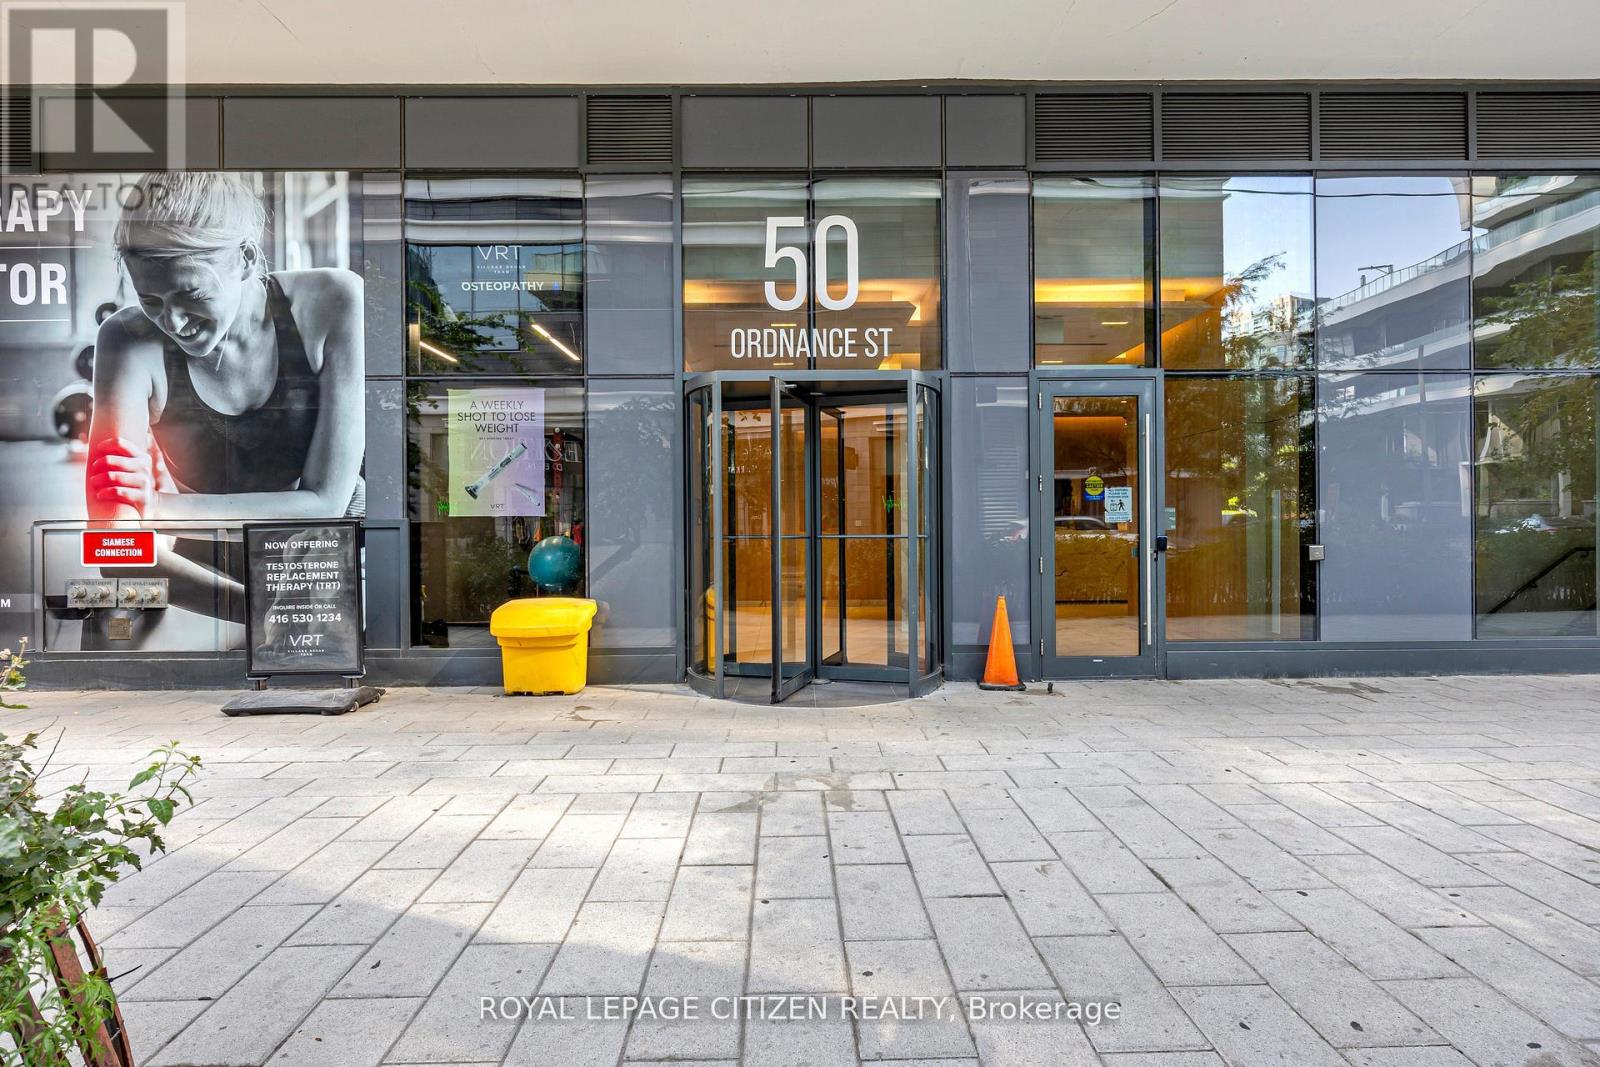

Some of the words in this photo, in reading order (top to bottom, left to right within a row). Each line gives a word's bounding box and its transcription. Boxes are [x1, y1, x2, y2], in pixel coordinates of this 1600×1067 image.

[0, 189, 93, 233] APY
[477, 245, 523, 260] VRT
[764, 215, 859, 311] 50
[461, 281, 545, 291] OSTEOPATHY
[730, 328, 858, 358] ORDNANCE
[864, 328, 893, 357] ST
[469, 400, 478, 410] A
[481, 400, 524, 410] WEEKLY
[457, 411, 486, 422] SHOT
[490, 411, 506, 422] TO
[509, 411, 536, 422] LOSE
[474, 423, 520, 433] WEIGHT
[102, 538, 136, 547] SIAMESE
[264, 541, 288, 550] NOW
[290, 540, 339, 549] OFFERING
[94, 548, 143, 557] CONNECTION
[265, 561, 339, 571] TESTOSTERONE
[266, 571, 339, 581] REPLACEMENT
[265, 582, 313, 592] THERAPY
[316, 581, 341, 591] (TRT)
[268, 614, 289, 624] 416
[292, 613, 314, 623] 530
[316, 612, 342, 622] 1234
[289, 634, 324, 647] VRT
